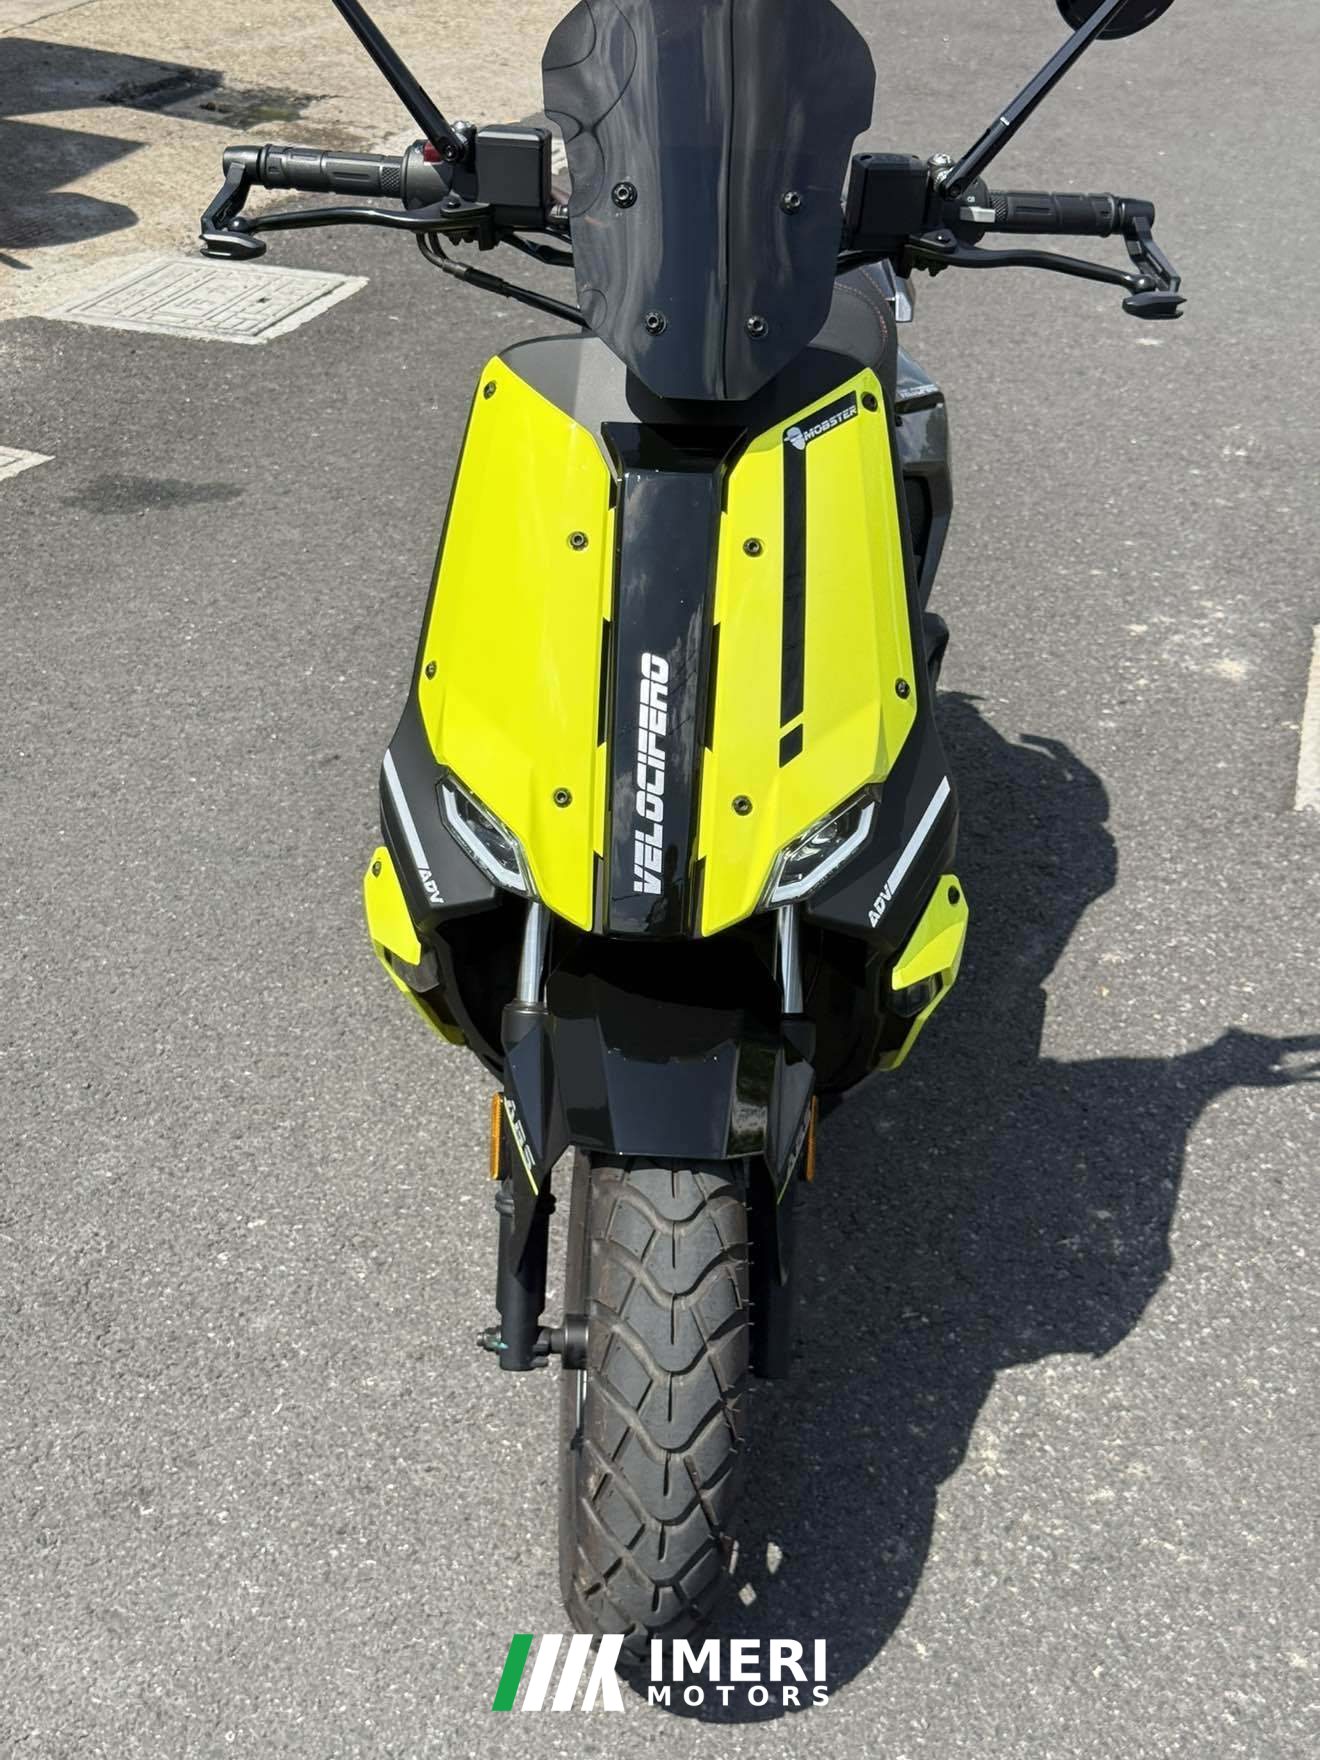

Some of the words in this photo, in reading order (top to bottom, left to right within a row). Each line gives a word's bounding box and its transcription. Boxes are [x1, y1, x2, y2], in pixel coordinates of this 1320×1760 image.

[803, 405, 857, 442] MOBSTER
[633, 652, 670, 895] VELOCIFERO
[418, 869, 445, 904] ADV
[868, 883, 892, 928] ADV
